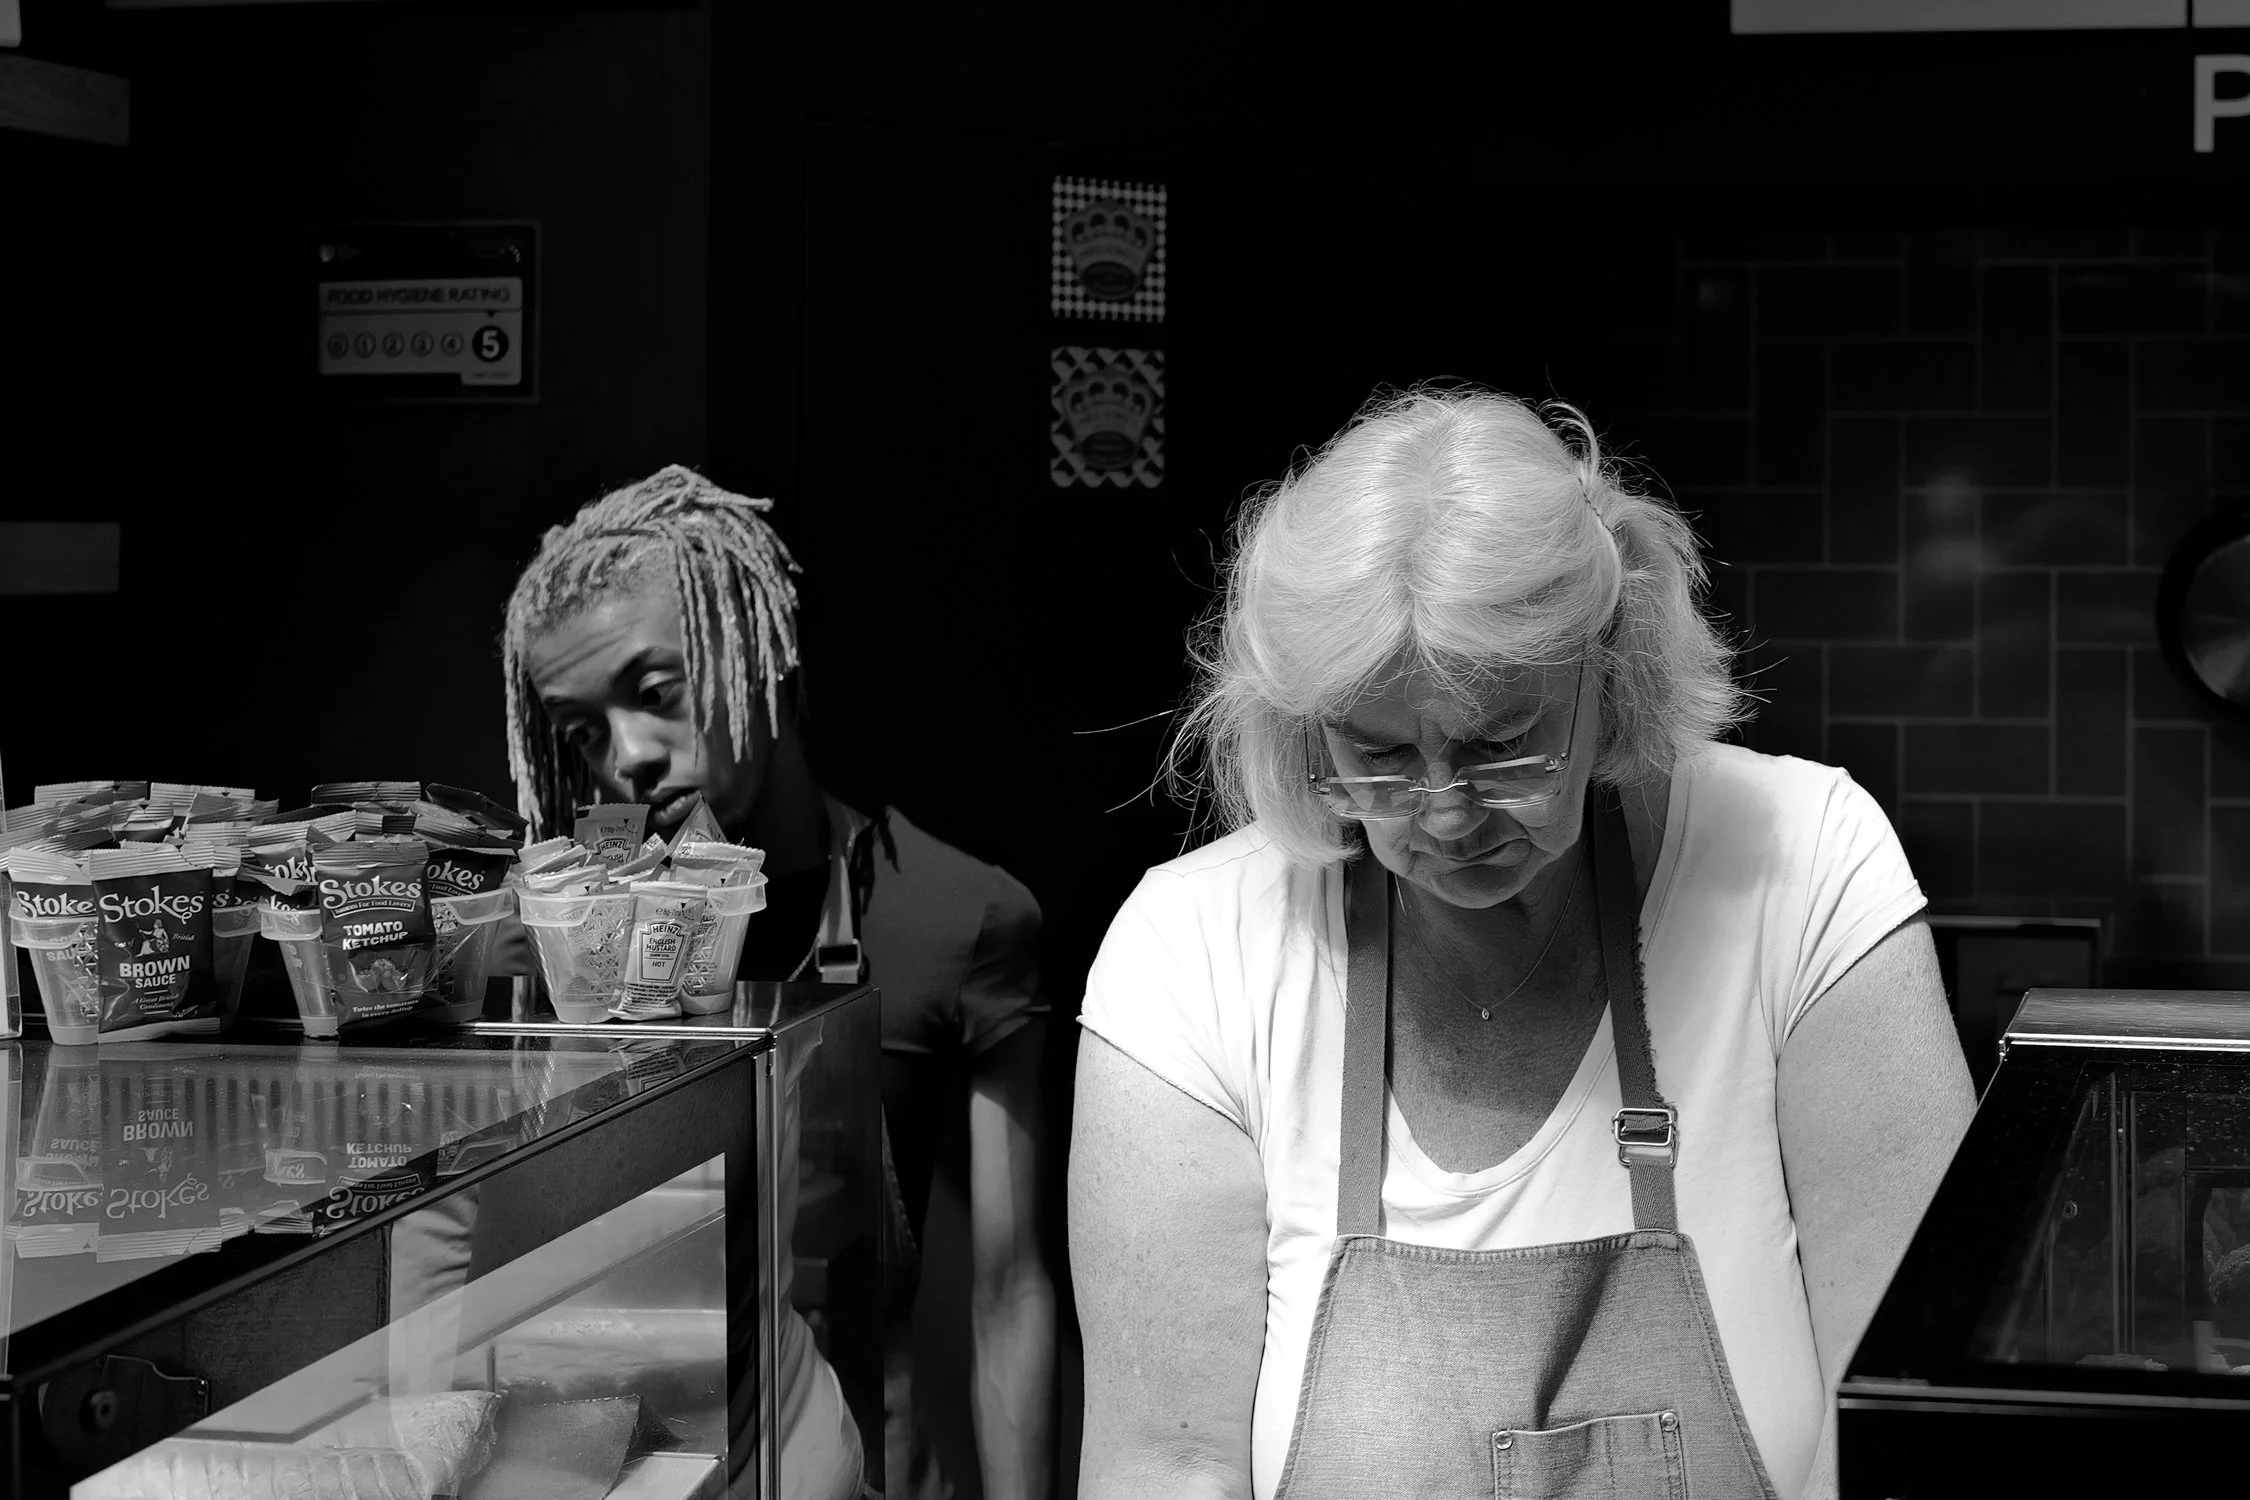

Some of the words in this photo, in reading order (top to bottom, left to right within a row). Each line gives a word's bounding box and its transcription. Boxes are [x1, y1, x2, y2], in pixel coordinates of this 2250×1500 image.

[2193, 53, 2250, 153] P
[327, 288, 373, 305] FOOD
[375, 287, 443, 303] HYGIENE
[448, 286, 511, 303] RATING
[480, 329, 500, 359] 5
[600, 840, 623, 851] HEINZ
[427, 860, 485, 890] okes
[320, 875, 422, 909] Stokes
[16, 891, 97, 919] Stoke
[99, 885, 205, 925] Stokes
[342, 920, 403, 937] TOMATO
[652, 925, 678, 935] HEINZ
[342, 931, 409, 951] KETCHUP
[646, 944, 676, 952] MUSTARD
[649, 938, 676, 946] ENGLISH
[119, 955, 191, 978] BROWN
[135, 973, 177, 989] SAUCE
